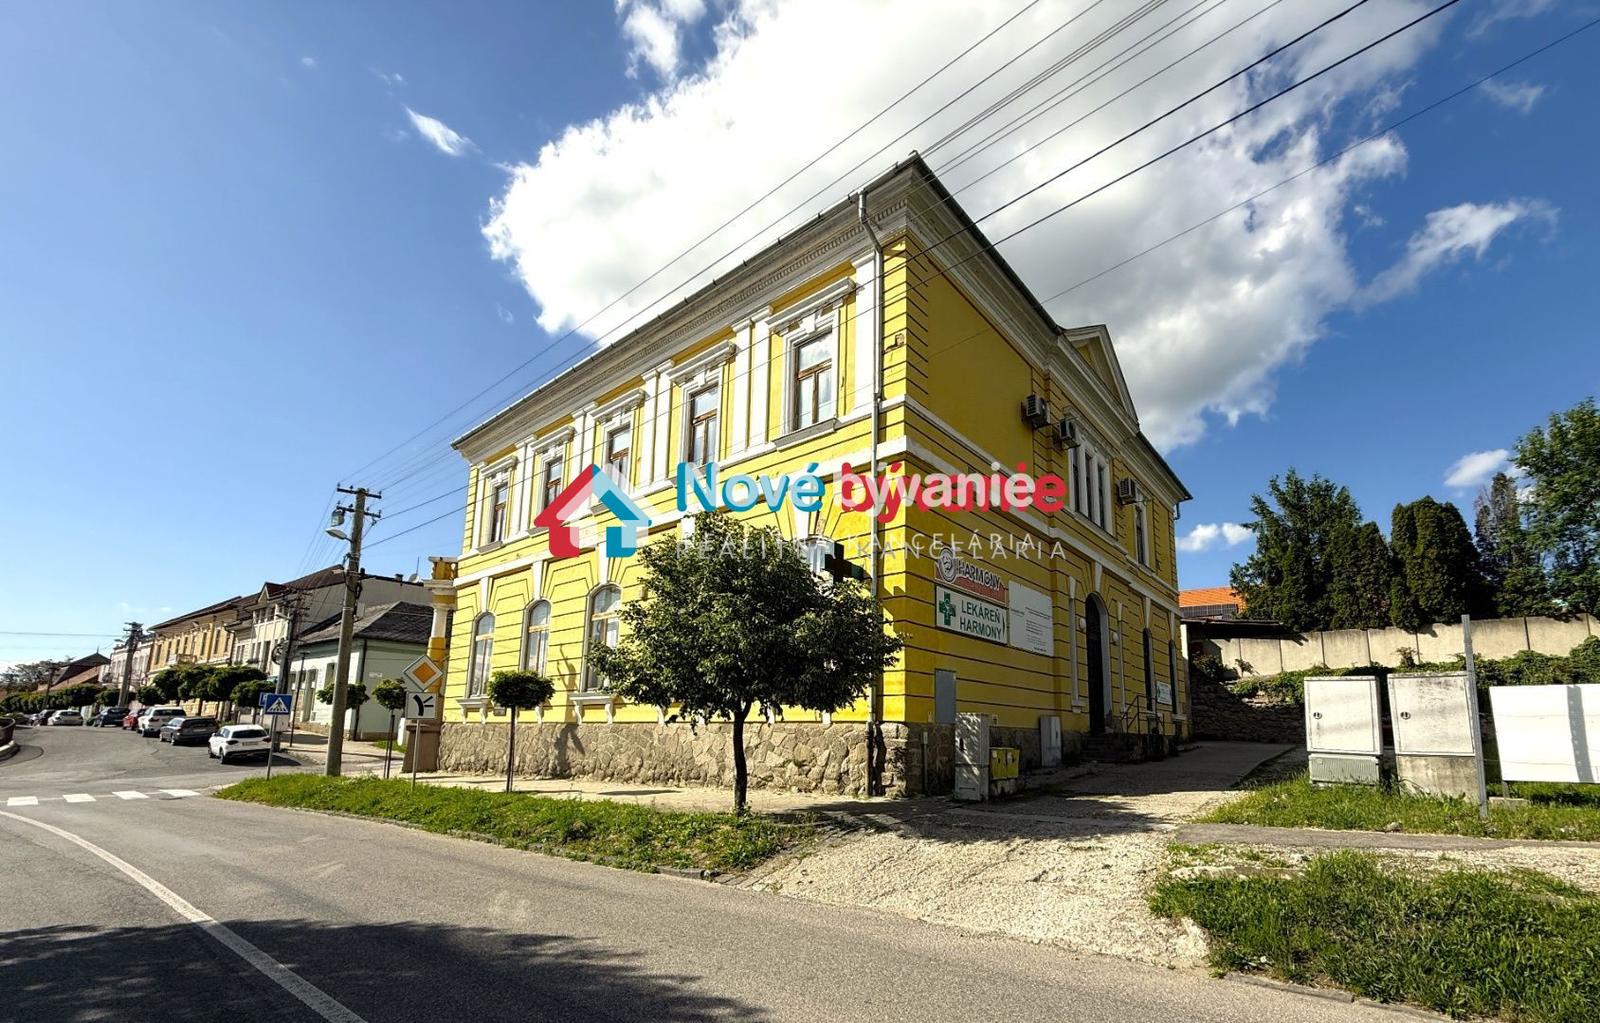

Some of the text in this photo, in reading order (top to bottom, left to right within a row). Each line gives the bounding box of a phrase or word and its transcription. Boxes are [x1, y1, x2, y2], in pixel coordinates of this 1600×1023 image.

[958, 560, 1001, 590] HARMONY
[961, 600, 1001, 624] LEKÁREŇ
[960, 617, 1002, 640] HARMONY
